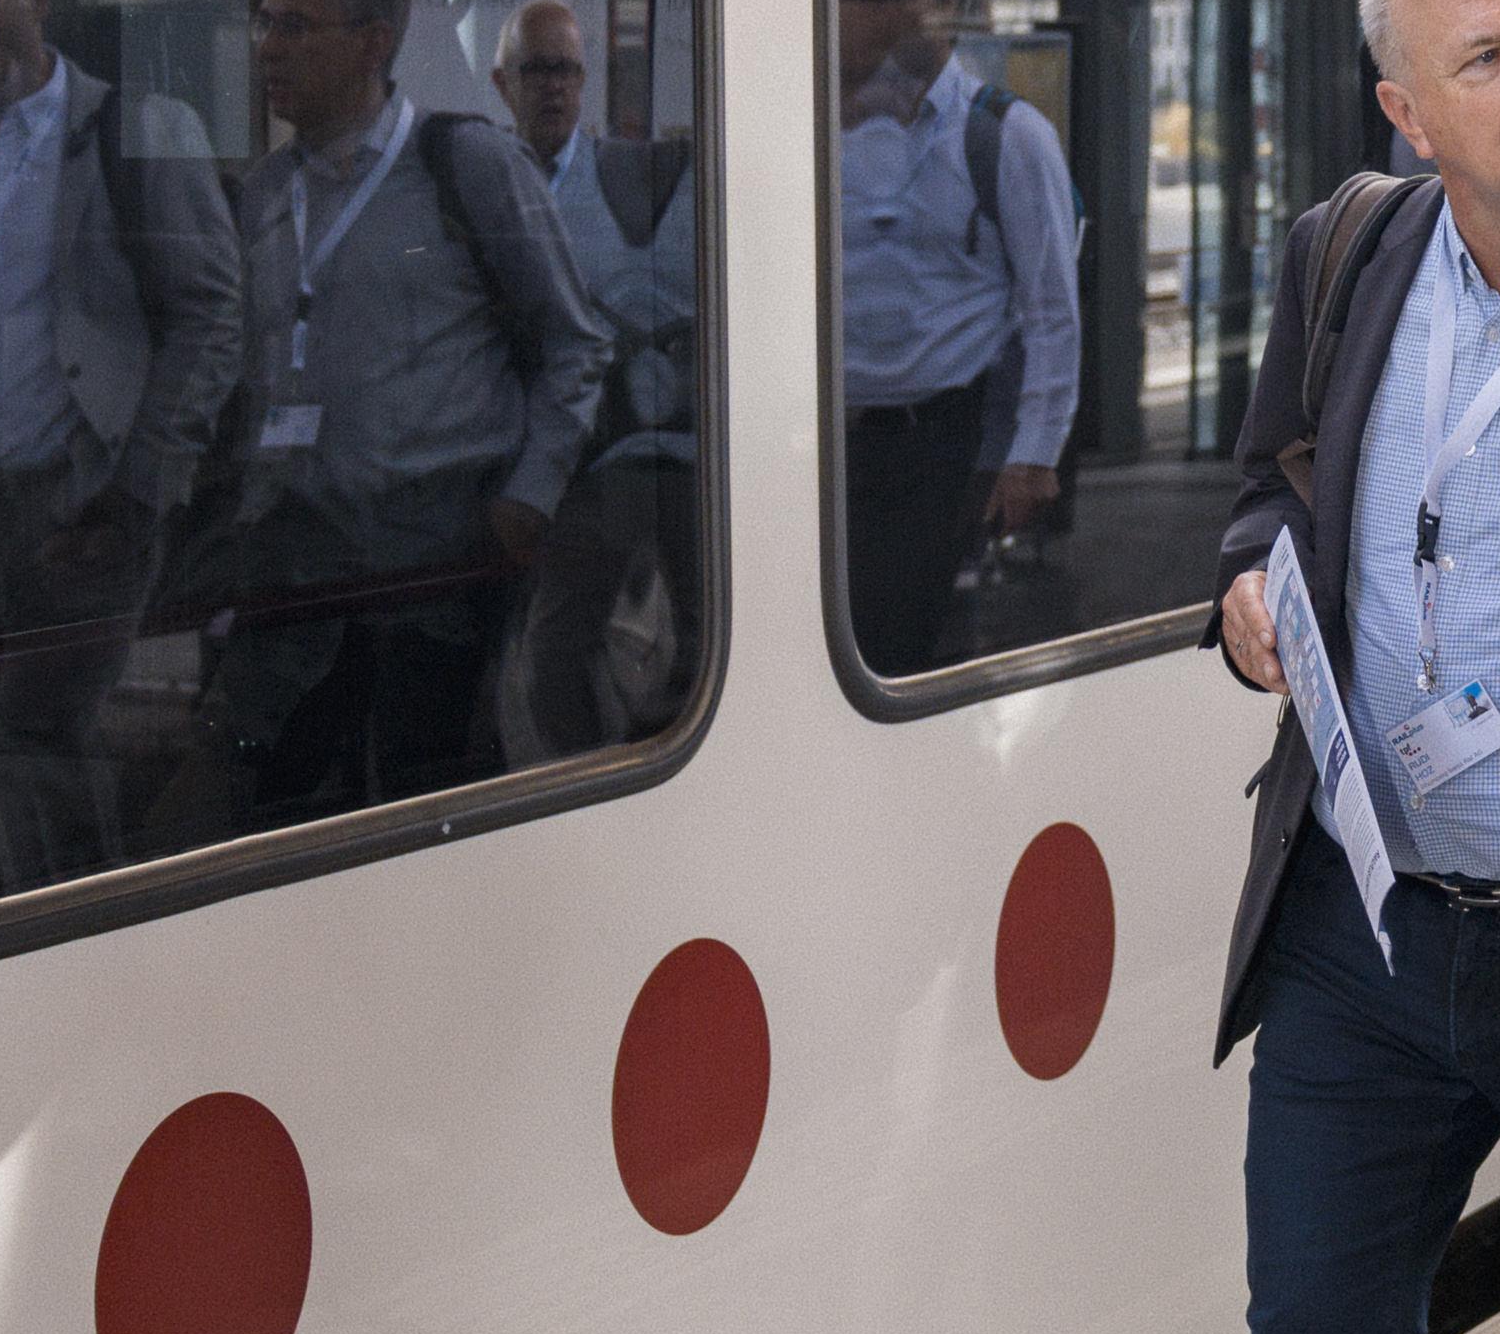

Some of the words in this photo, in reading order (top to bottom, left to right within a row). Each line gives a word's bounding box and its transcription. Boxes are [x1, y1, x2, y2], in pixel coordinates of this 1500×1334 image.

[1391, 724, 1424, 746] RAILplus
[1399, 743, 1412, 756] tpf
[1408, 753, 1431, 771] RUDI
[1414, 765, 1436, 781] HOZ
